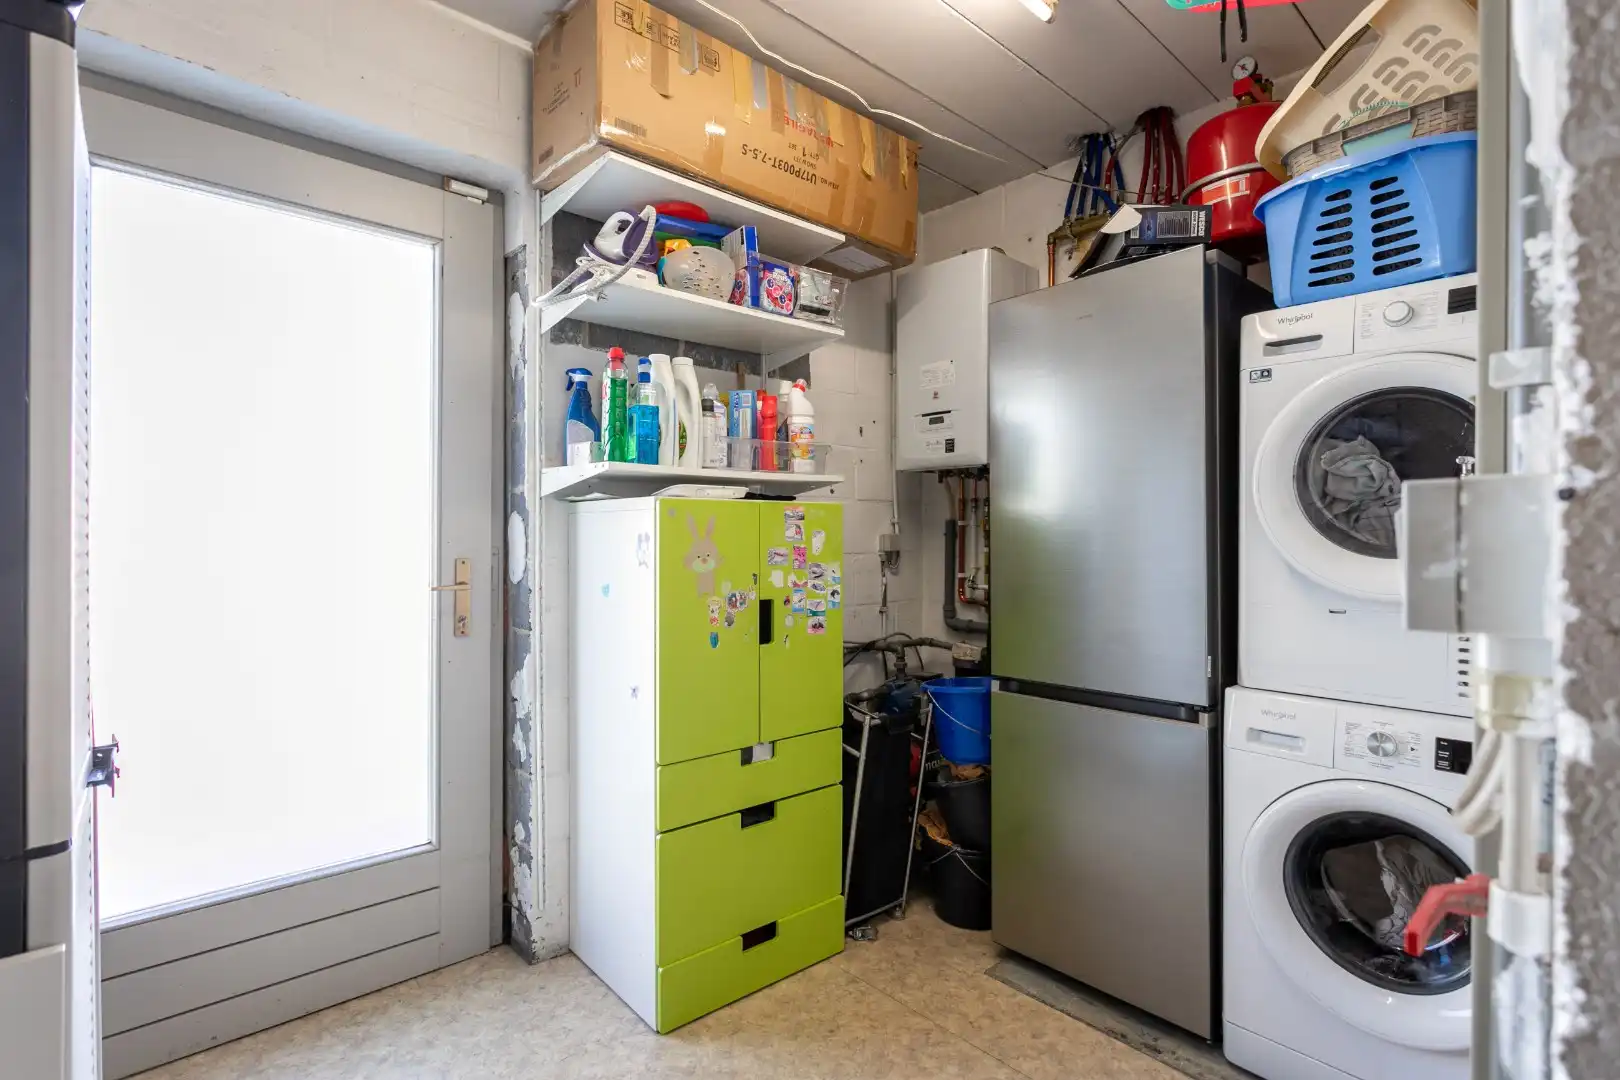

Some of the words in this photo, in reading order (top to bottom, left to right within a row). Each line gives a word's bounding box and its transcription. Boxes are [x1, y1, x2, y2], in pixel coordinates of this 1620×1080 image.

[741, 143, 817, 186] U17P003T-7.5-S
[1277, 312, 1313, 325] Whirlpool
[1260, 709, 1296, 720] Whirlpool
